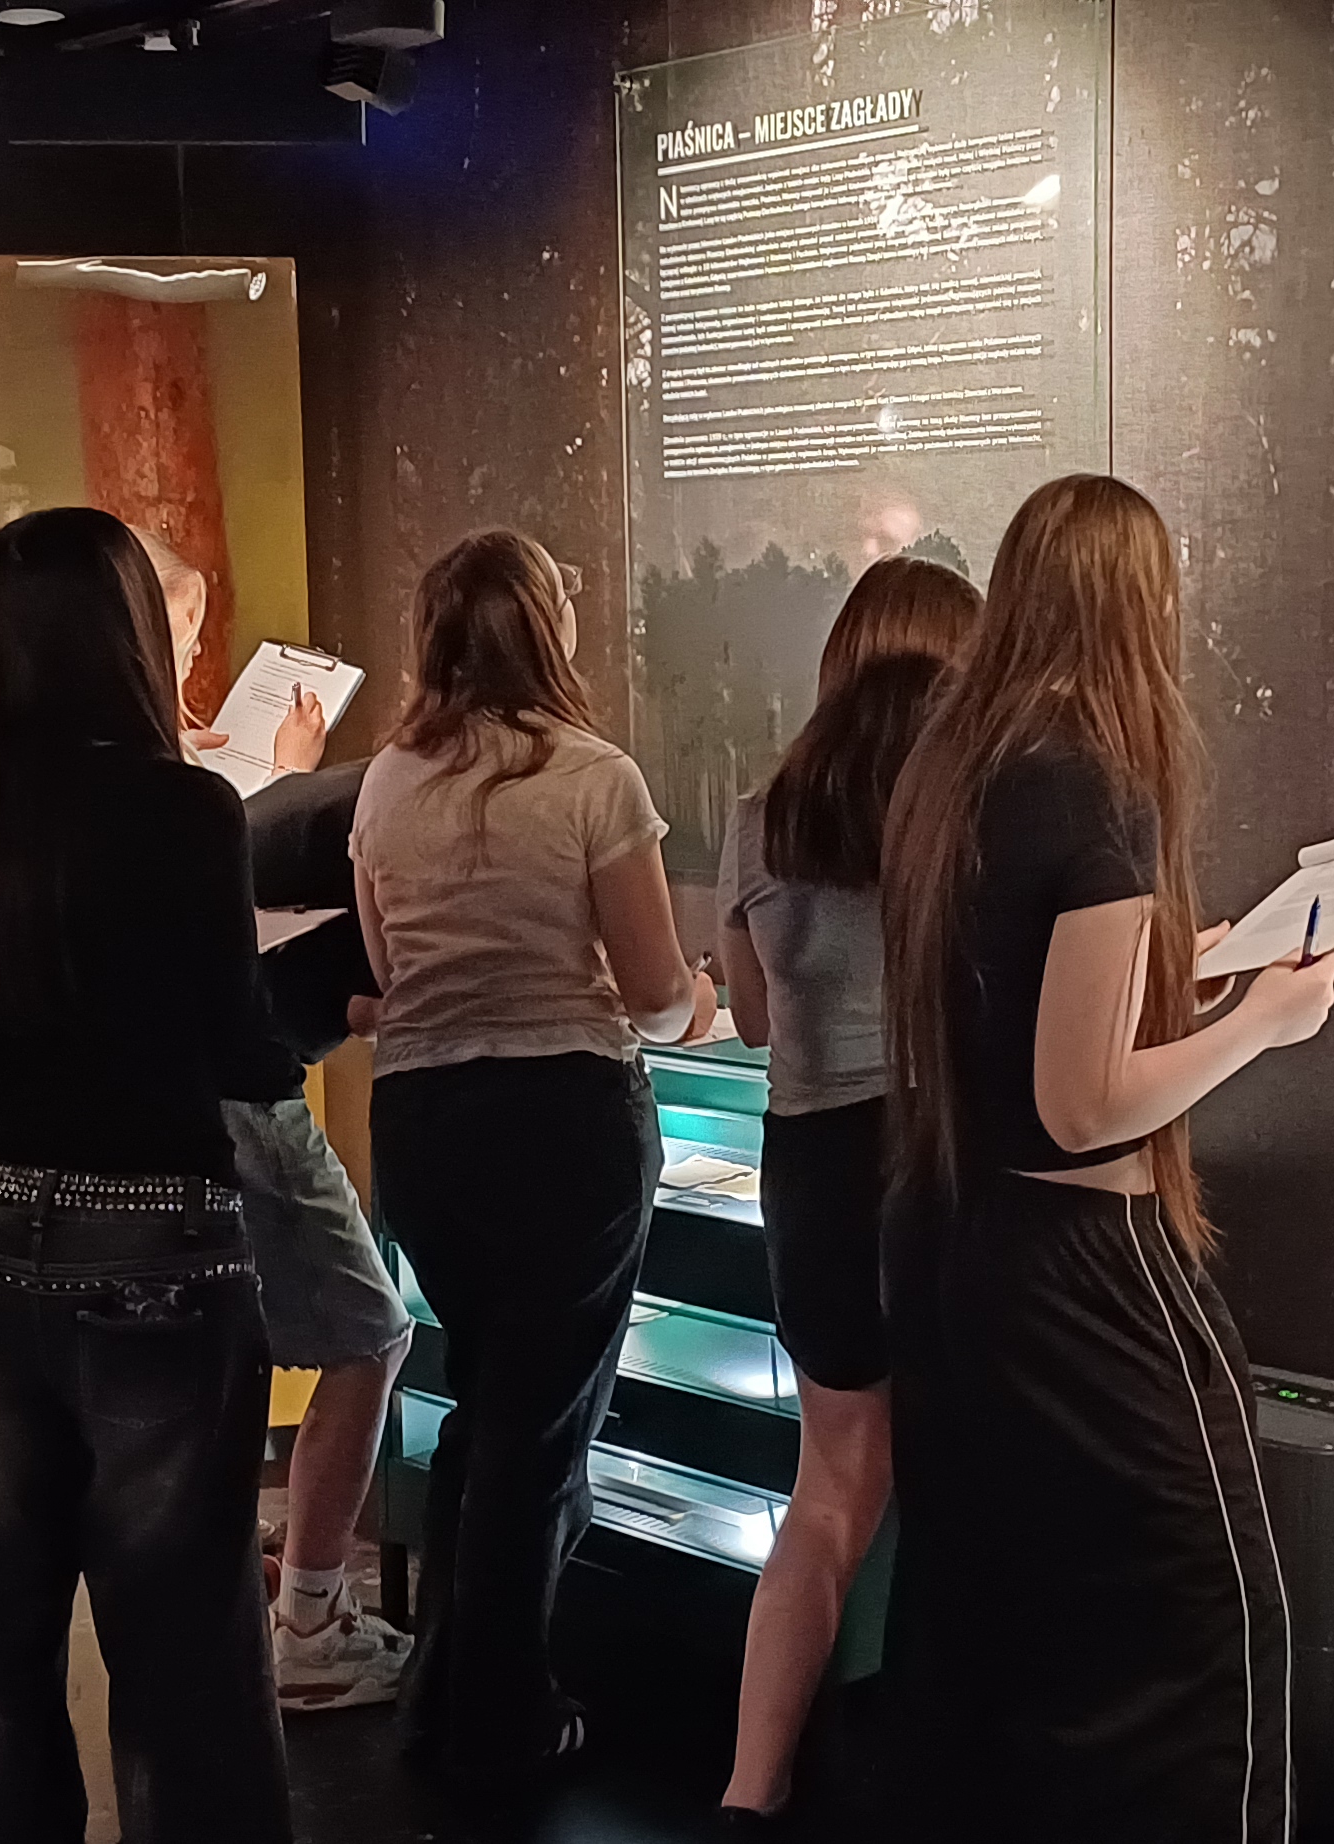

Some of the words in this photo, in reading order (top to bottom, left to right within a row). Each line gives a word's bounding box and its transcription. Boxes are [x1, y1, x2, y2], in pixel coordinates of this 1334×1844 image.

[657, 121, 735, 162] PIAŚNICA
[755, 104, 826, 145] MIEJSCE
[830, 88, 913, 131] ZAGŁADY
